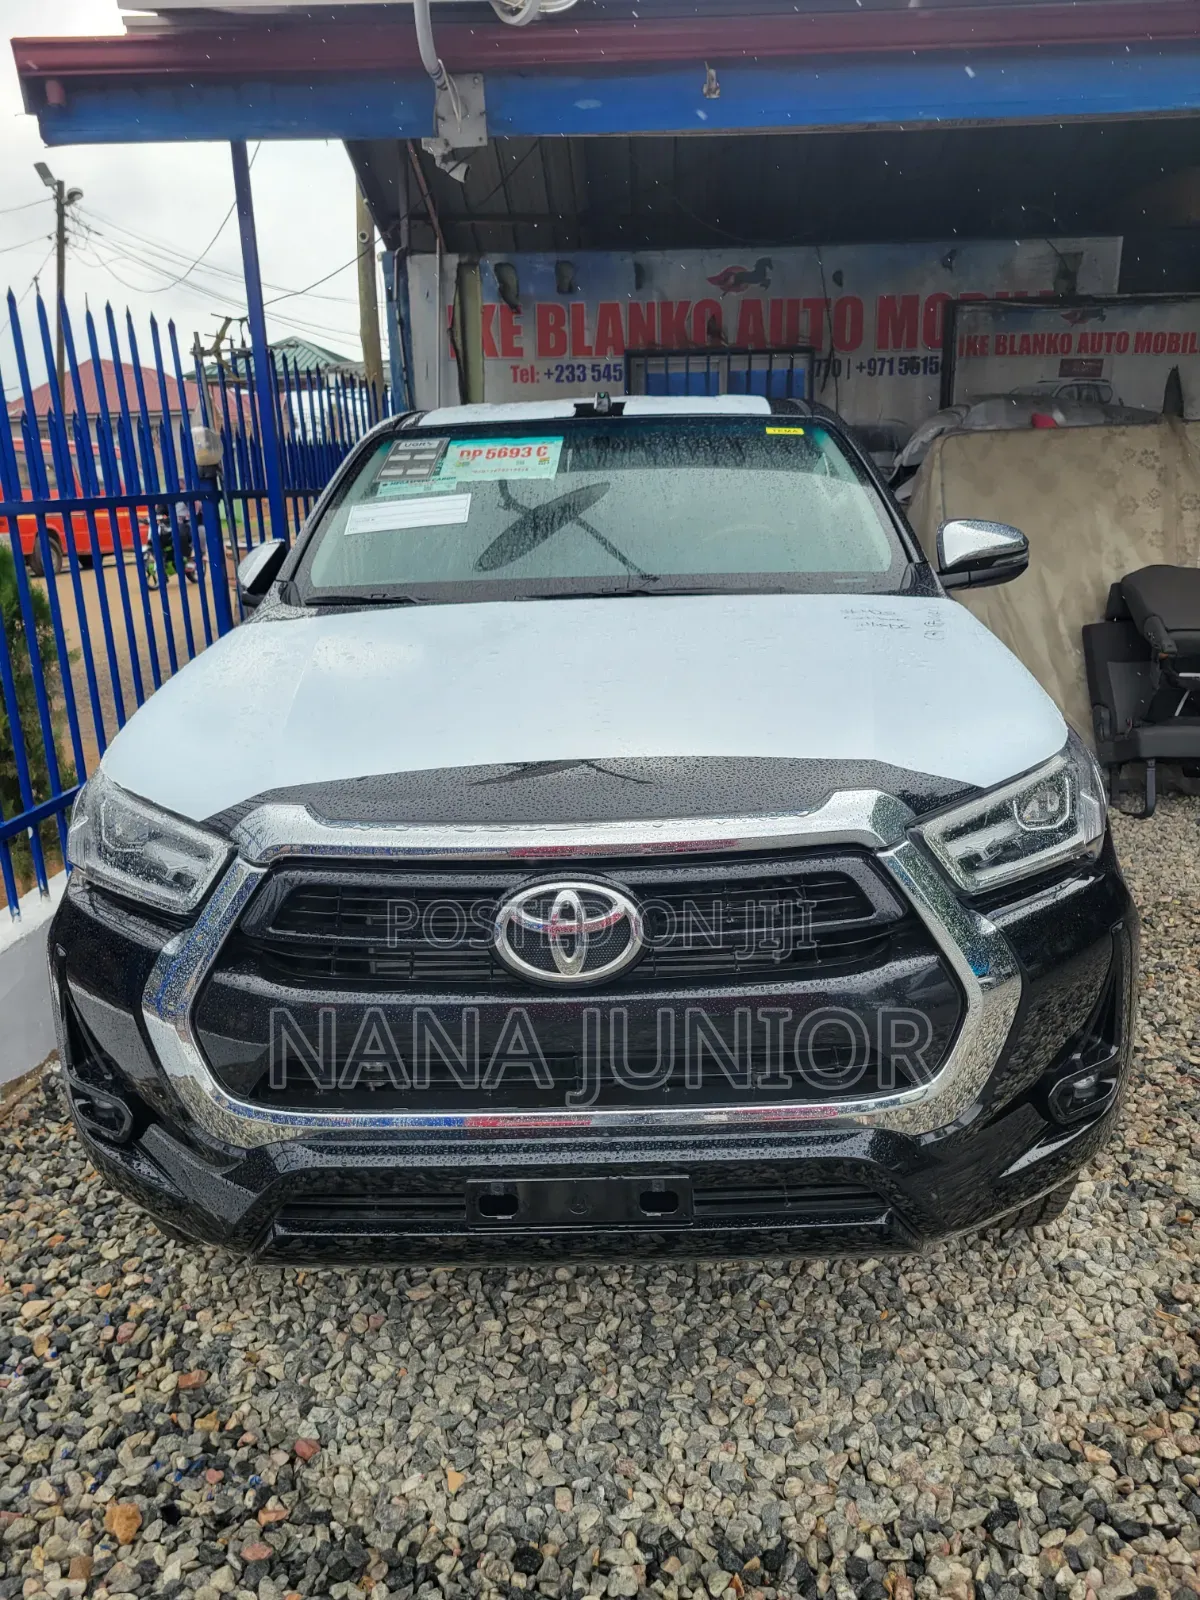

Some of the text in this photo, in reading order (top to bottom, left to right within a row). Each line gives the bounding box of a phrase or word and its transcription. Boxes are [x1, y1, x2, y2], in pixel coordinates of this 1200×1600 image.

[535, 298, 724, 357] BLANKO
[735, 295, 864, 352] AUTO
[957, 334, 990, 357] IKE
[994, 332, 1073, 356] BLANKO
[1077, 331, 1130, 354] AUTO
[510, 364, 540, 384] Tel:
[544, 363, 587, 384] +233
[591, 363, 623, 382] 545
[855, 357, 894, 377] +971
[485, 446, 533, 461] 5693
[536, 445, 549, 458] C
